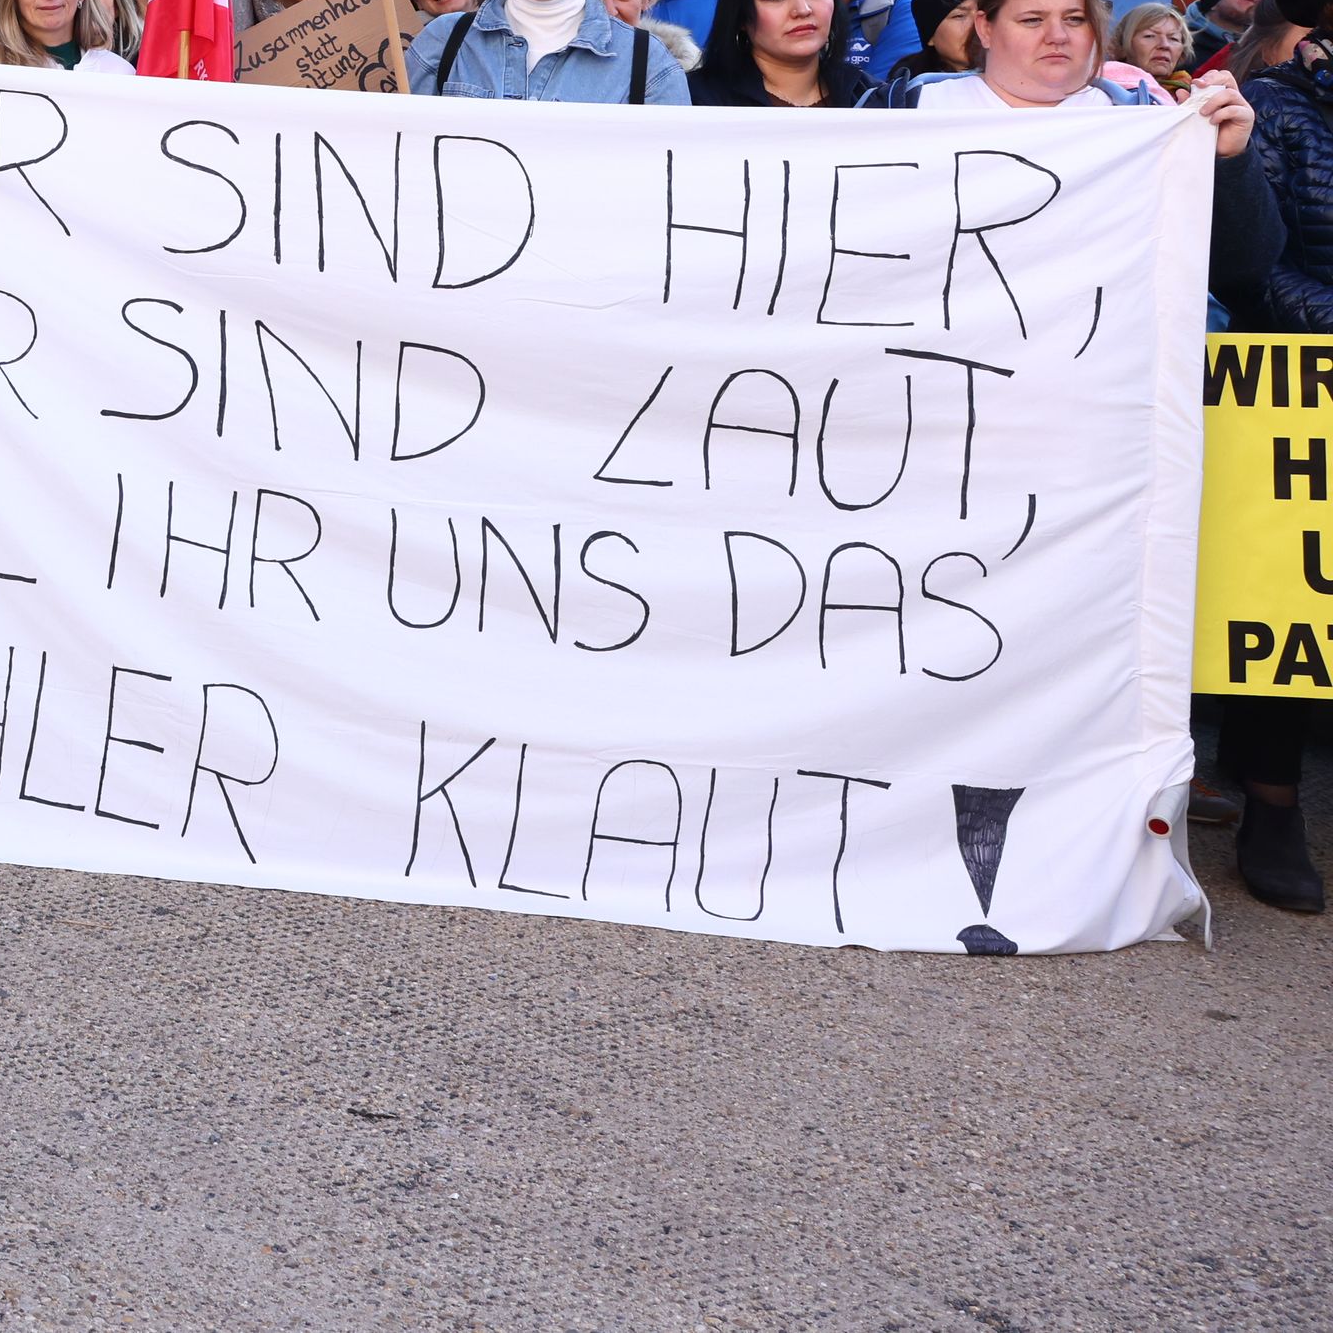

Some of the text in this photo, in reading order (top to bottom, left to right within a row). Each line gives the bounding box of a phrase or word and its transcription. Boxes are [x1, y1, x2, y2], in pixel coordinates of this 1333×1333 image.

[296, 33, 343, 72] statt
[159, 120, 536, 290] SIND
[663, 149, 1104, 360] HIER,
[100, 297, 487, 462] SIND
[594, 348, 1037, 561] LAUT,
[107, 473, 321, 622] IHR
[387, 508, 651, 653] UNS
[724, 530, 1005, 683] DAS
[405, 720, 1027, 957] KLAUT!
